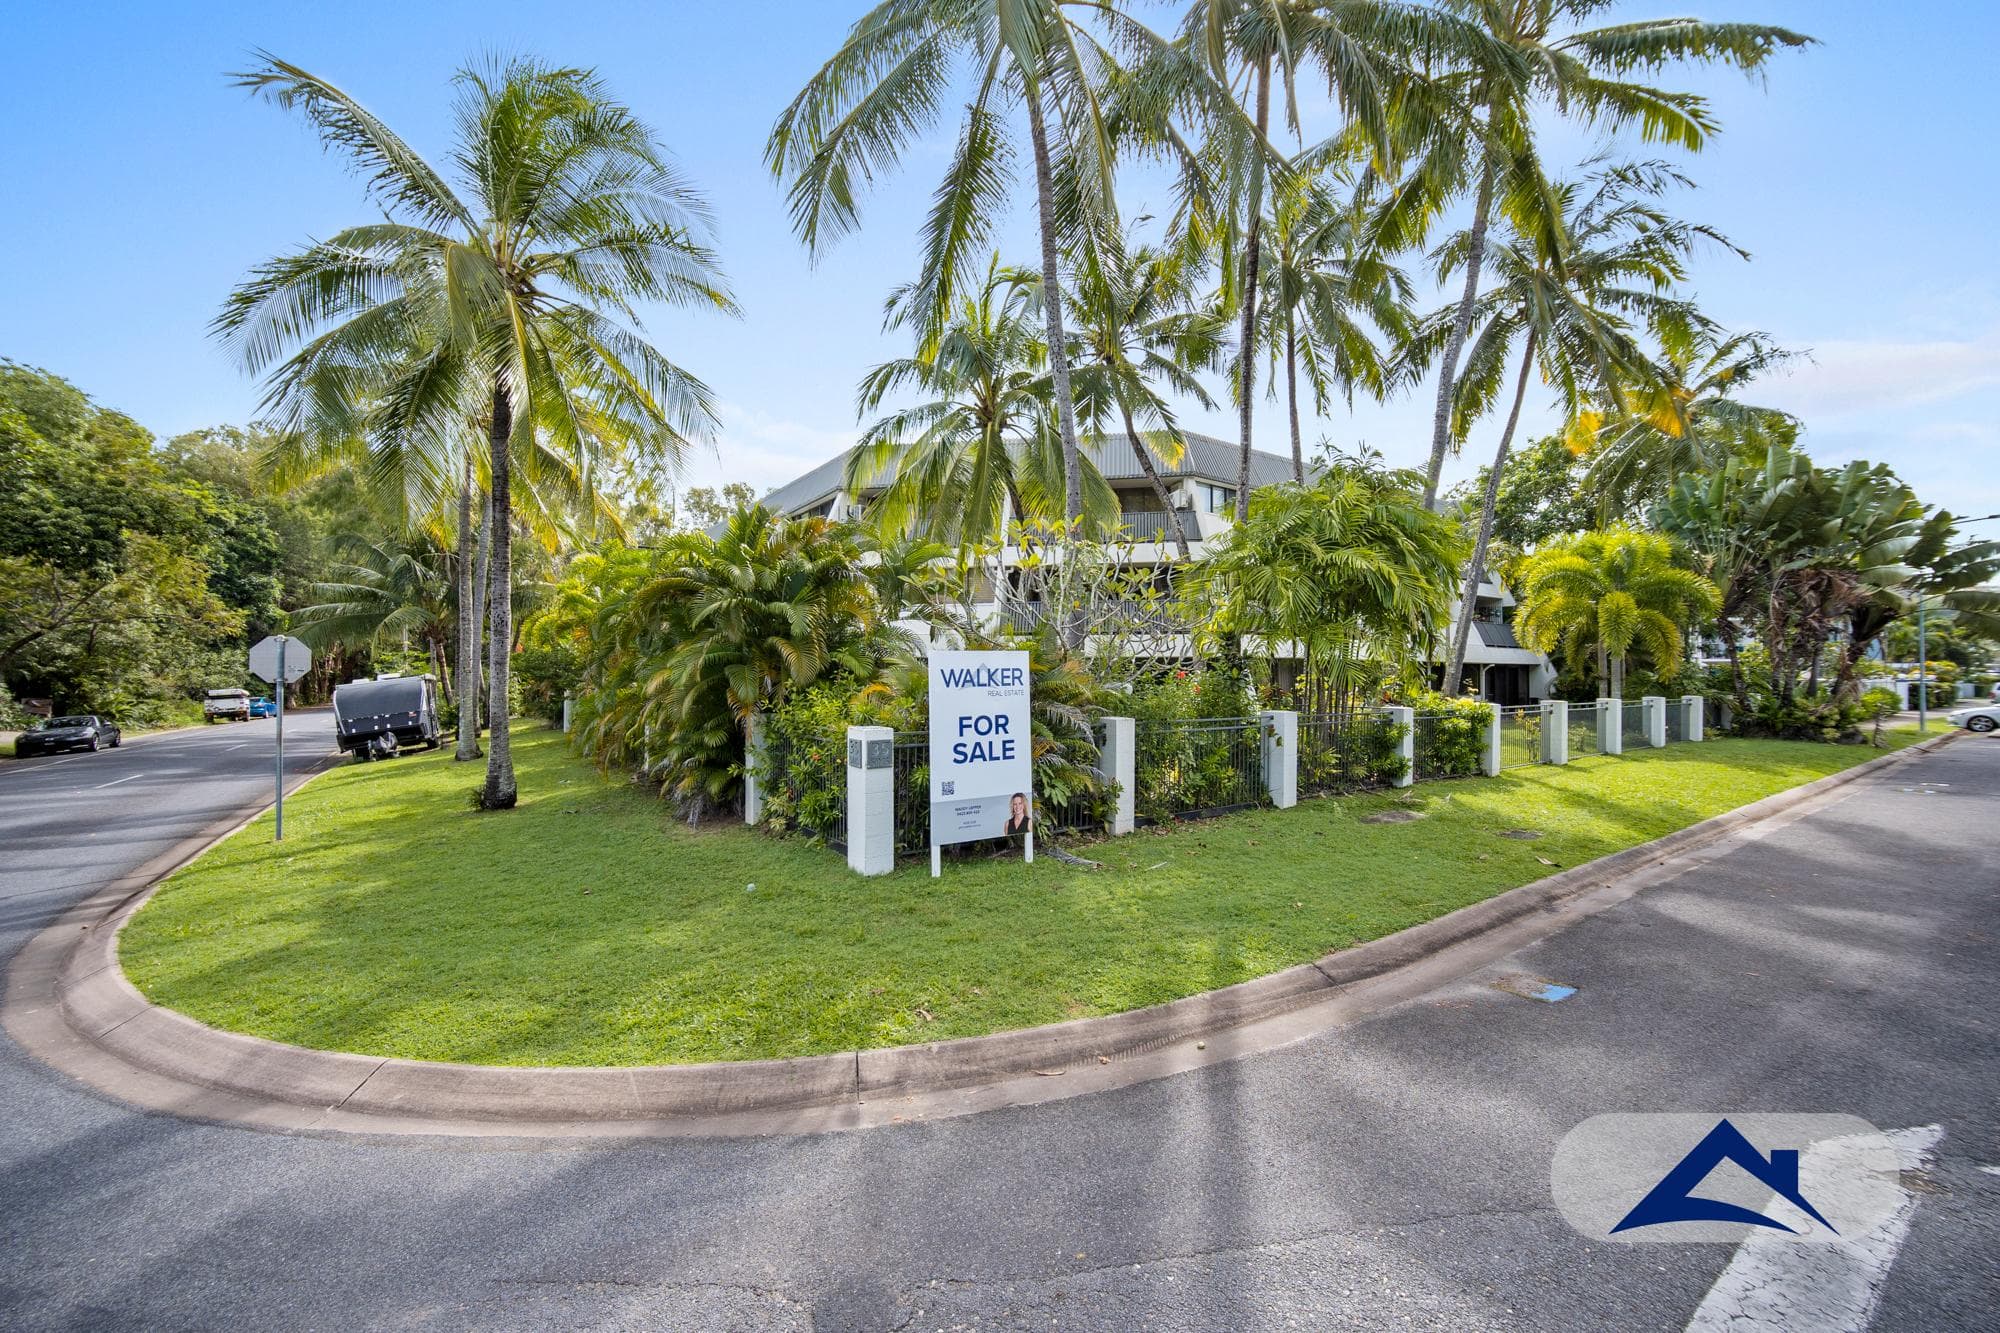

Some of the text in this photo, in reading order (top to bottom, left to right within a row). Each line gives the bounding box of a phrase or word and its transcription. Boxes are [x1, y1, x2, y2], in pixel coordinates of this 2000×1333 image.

[940, 668, 1024, 688] WALKER
[958, 715, 1010, 737] FOR
[872, 743, 890, 757] 35
[952, 740, 1016, 765] SALE
